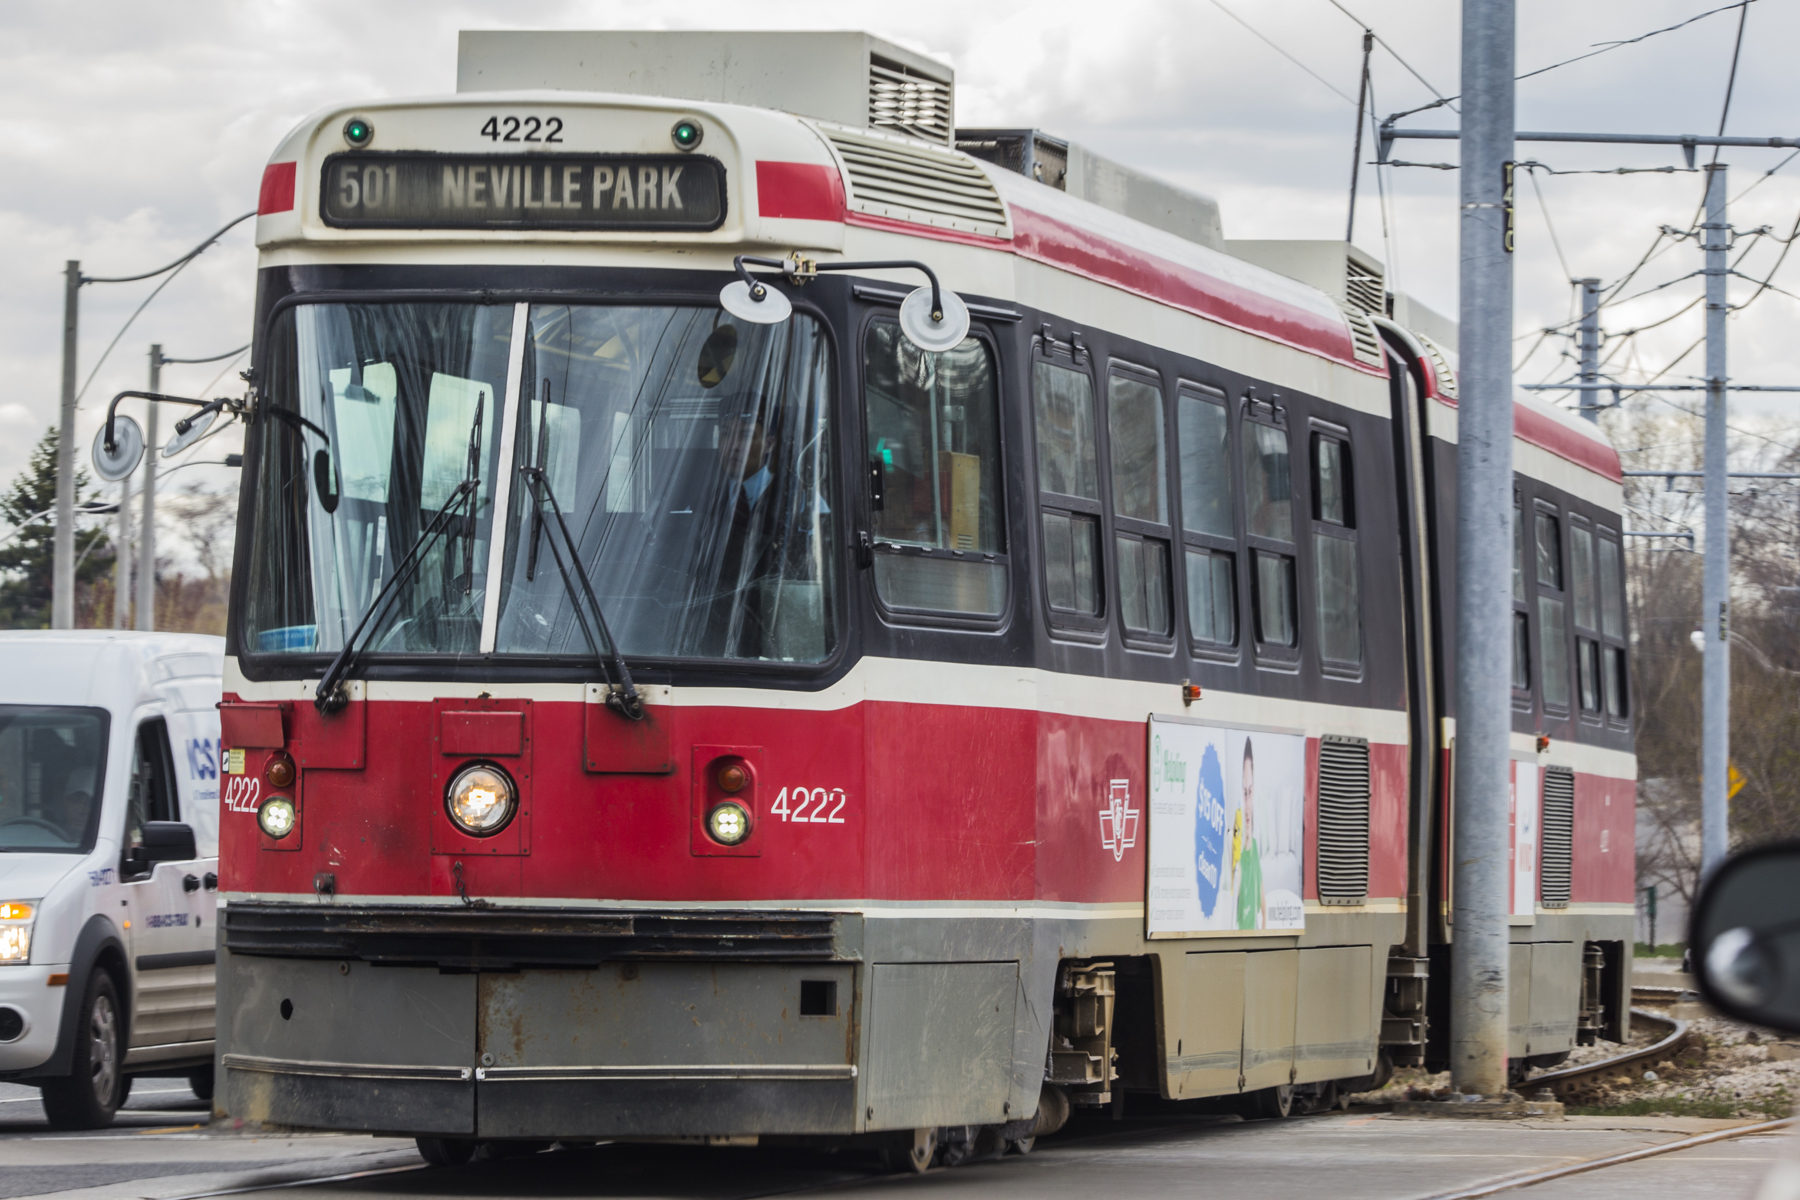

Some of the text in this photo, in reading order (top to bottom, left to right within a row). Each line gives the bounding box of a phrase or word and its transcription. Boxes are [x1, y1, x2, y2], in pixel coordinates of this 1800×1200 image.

[481, 116, 564, 143] 4222
[340, 165, 685, 210] 501 NEVILLE PARK
[224, 776, 260, 814] 4222
[771, 786, 846, 824] 4222
[1211, 798, 1225, 836] OFF
